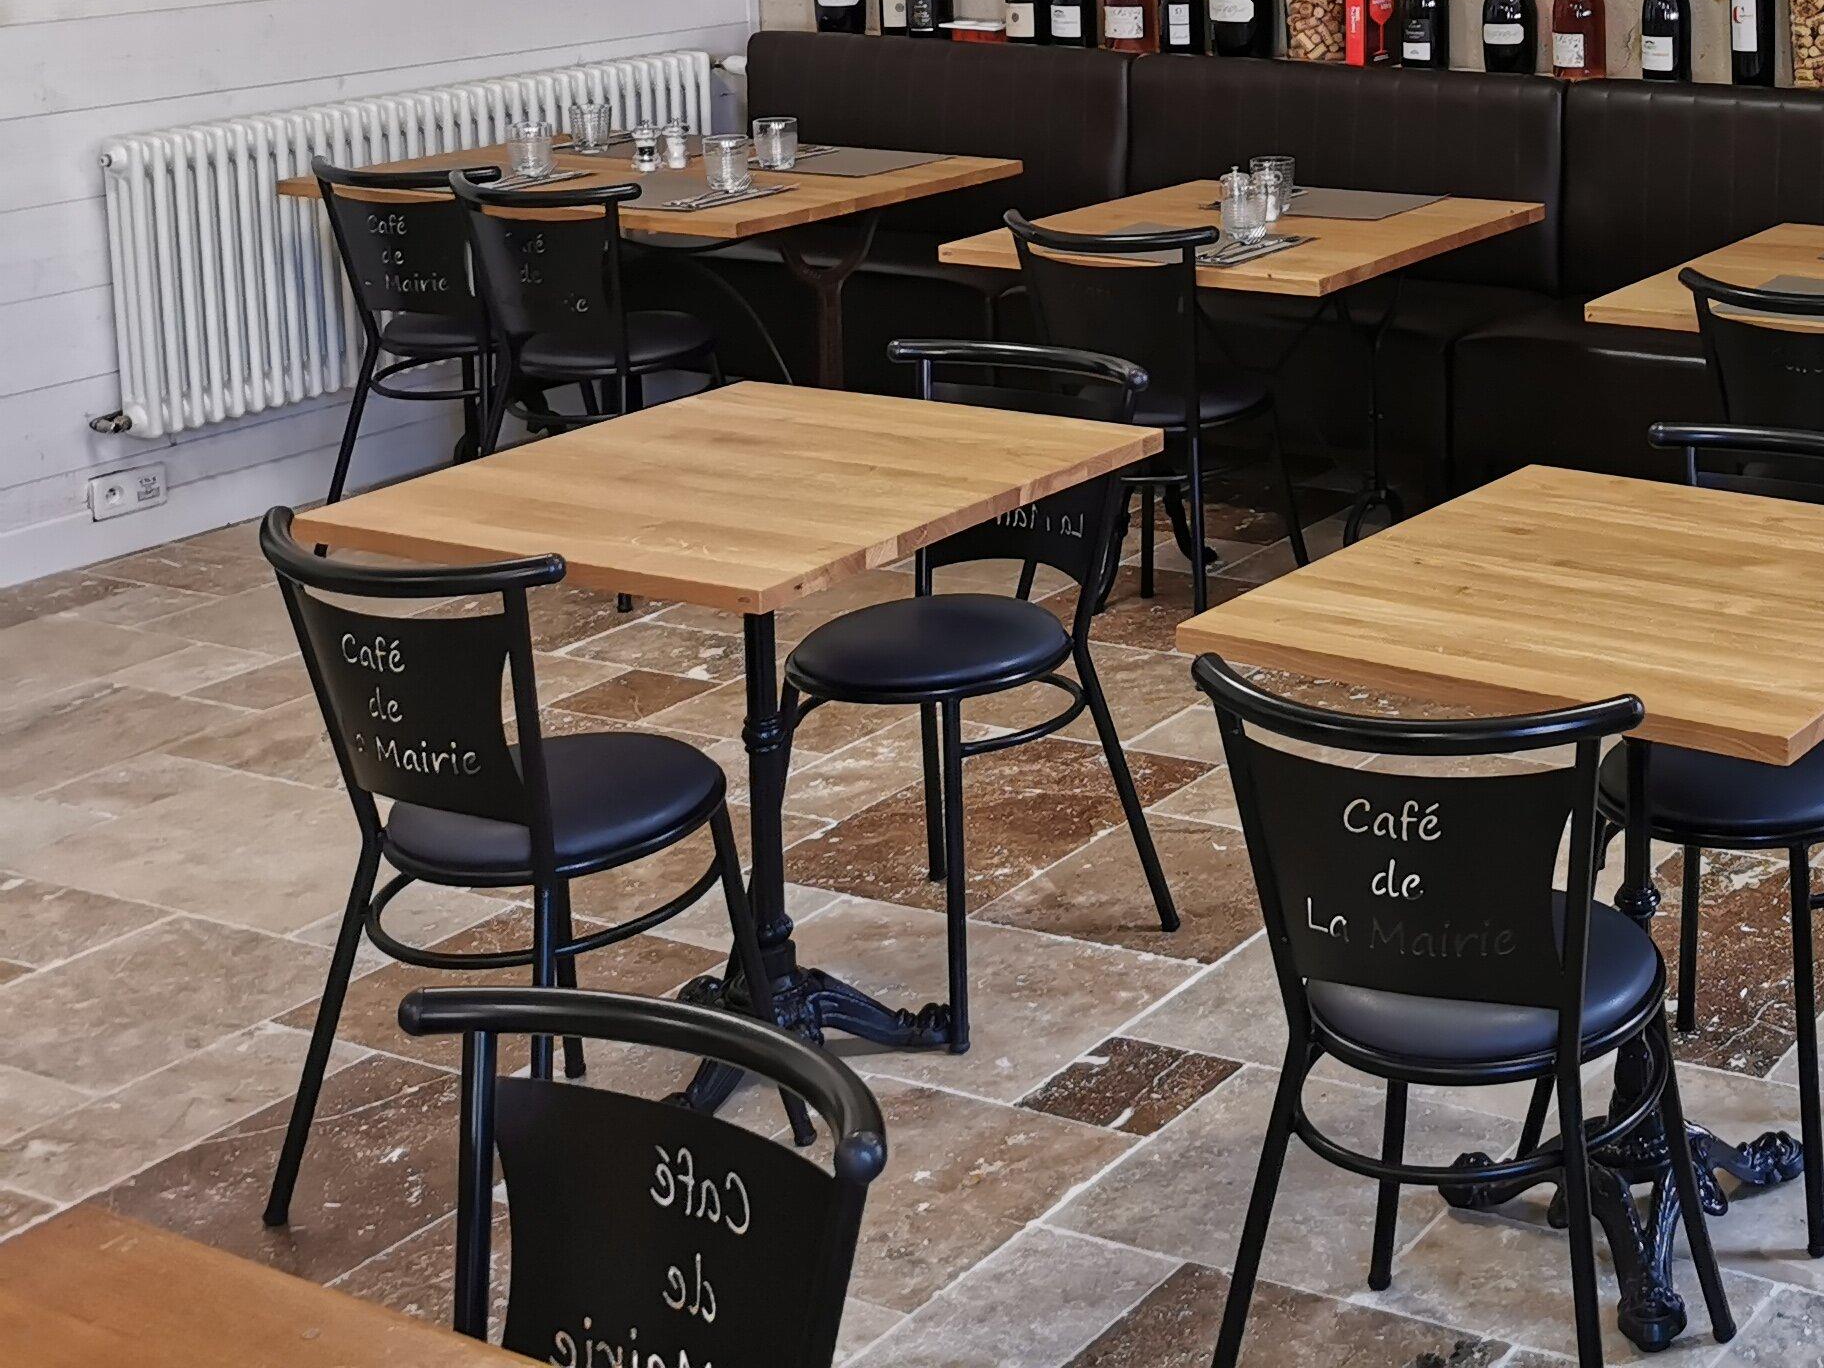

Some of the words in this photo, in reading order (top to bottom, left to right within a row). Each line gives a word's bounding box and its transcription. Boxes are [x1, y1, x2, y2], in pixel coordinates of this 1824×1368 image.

[367, 213, 408, 236] Café
[382, 249, 405, 266] de
[341, 632, 406, 674] Café
[369, 686, 403, 723] de
[375, 735, 482, 776] Mairie
[1343, 798, 1442, 842] Café
[1371, 859, 1424, 901] de
[1307, 896, 1350, 943] La
